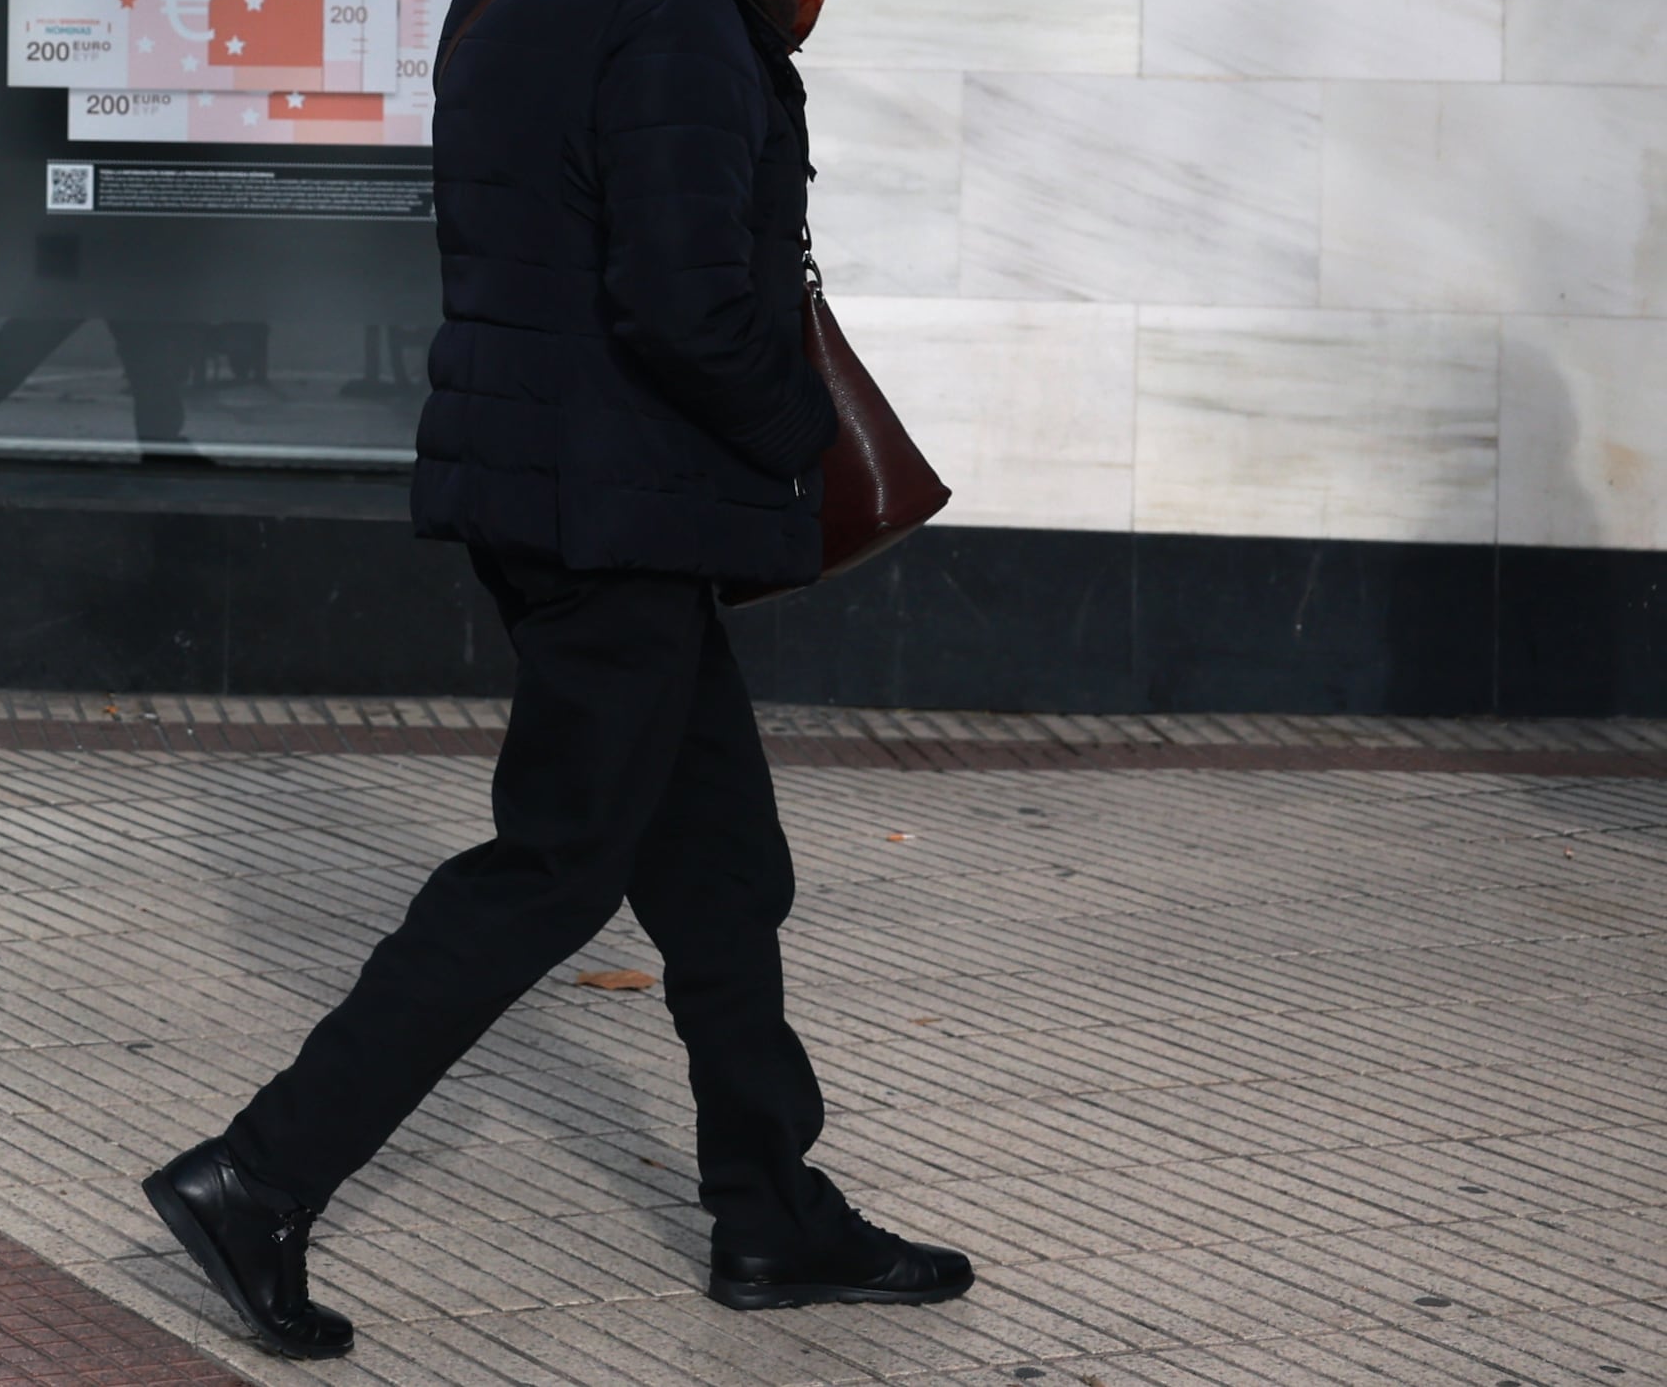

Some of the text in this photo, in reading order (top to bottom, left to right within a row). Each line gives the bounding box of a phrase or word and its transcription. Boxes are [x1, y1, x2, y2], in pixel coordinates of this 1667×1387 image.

[331, 6, 368, 24] 200
[27, 40, 112, 62] 200 EURO
[86, 94, 172, 115] 200 EURO
